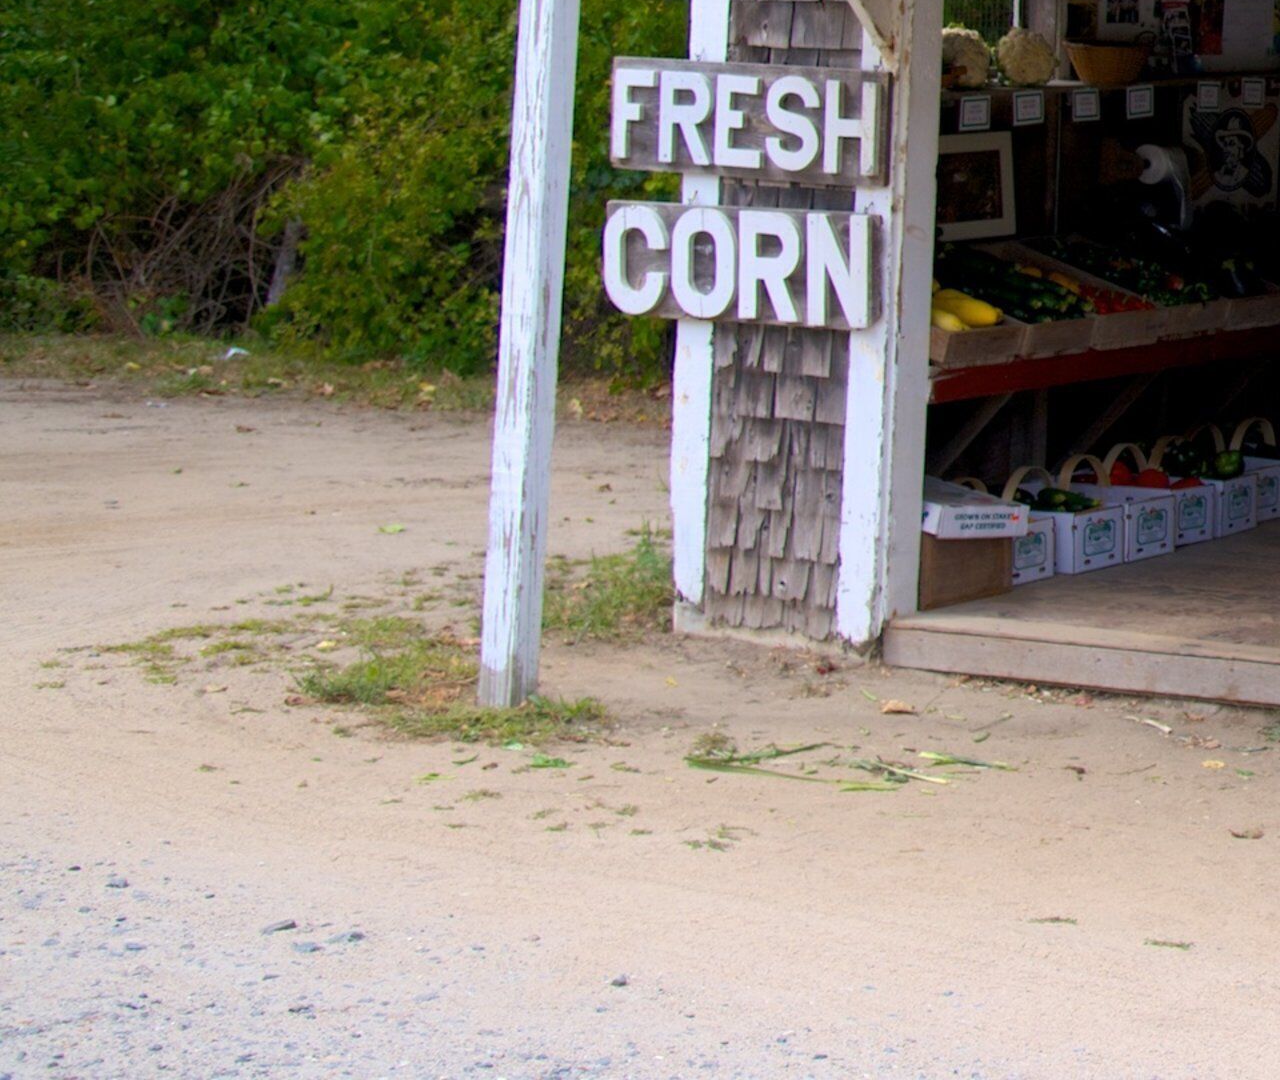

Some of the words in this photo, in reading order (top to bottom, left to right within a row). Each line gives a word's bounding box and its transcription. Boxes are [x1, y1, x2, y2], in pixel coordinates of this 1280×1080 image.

[611, 69, 880, 177] FRESH
[602, 204, 874, 330] CORN
[975, 522, 1007, 530] CERTIFIED
